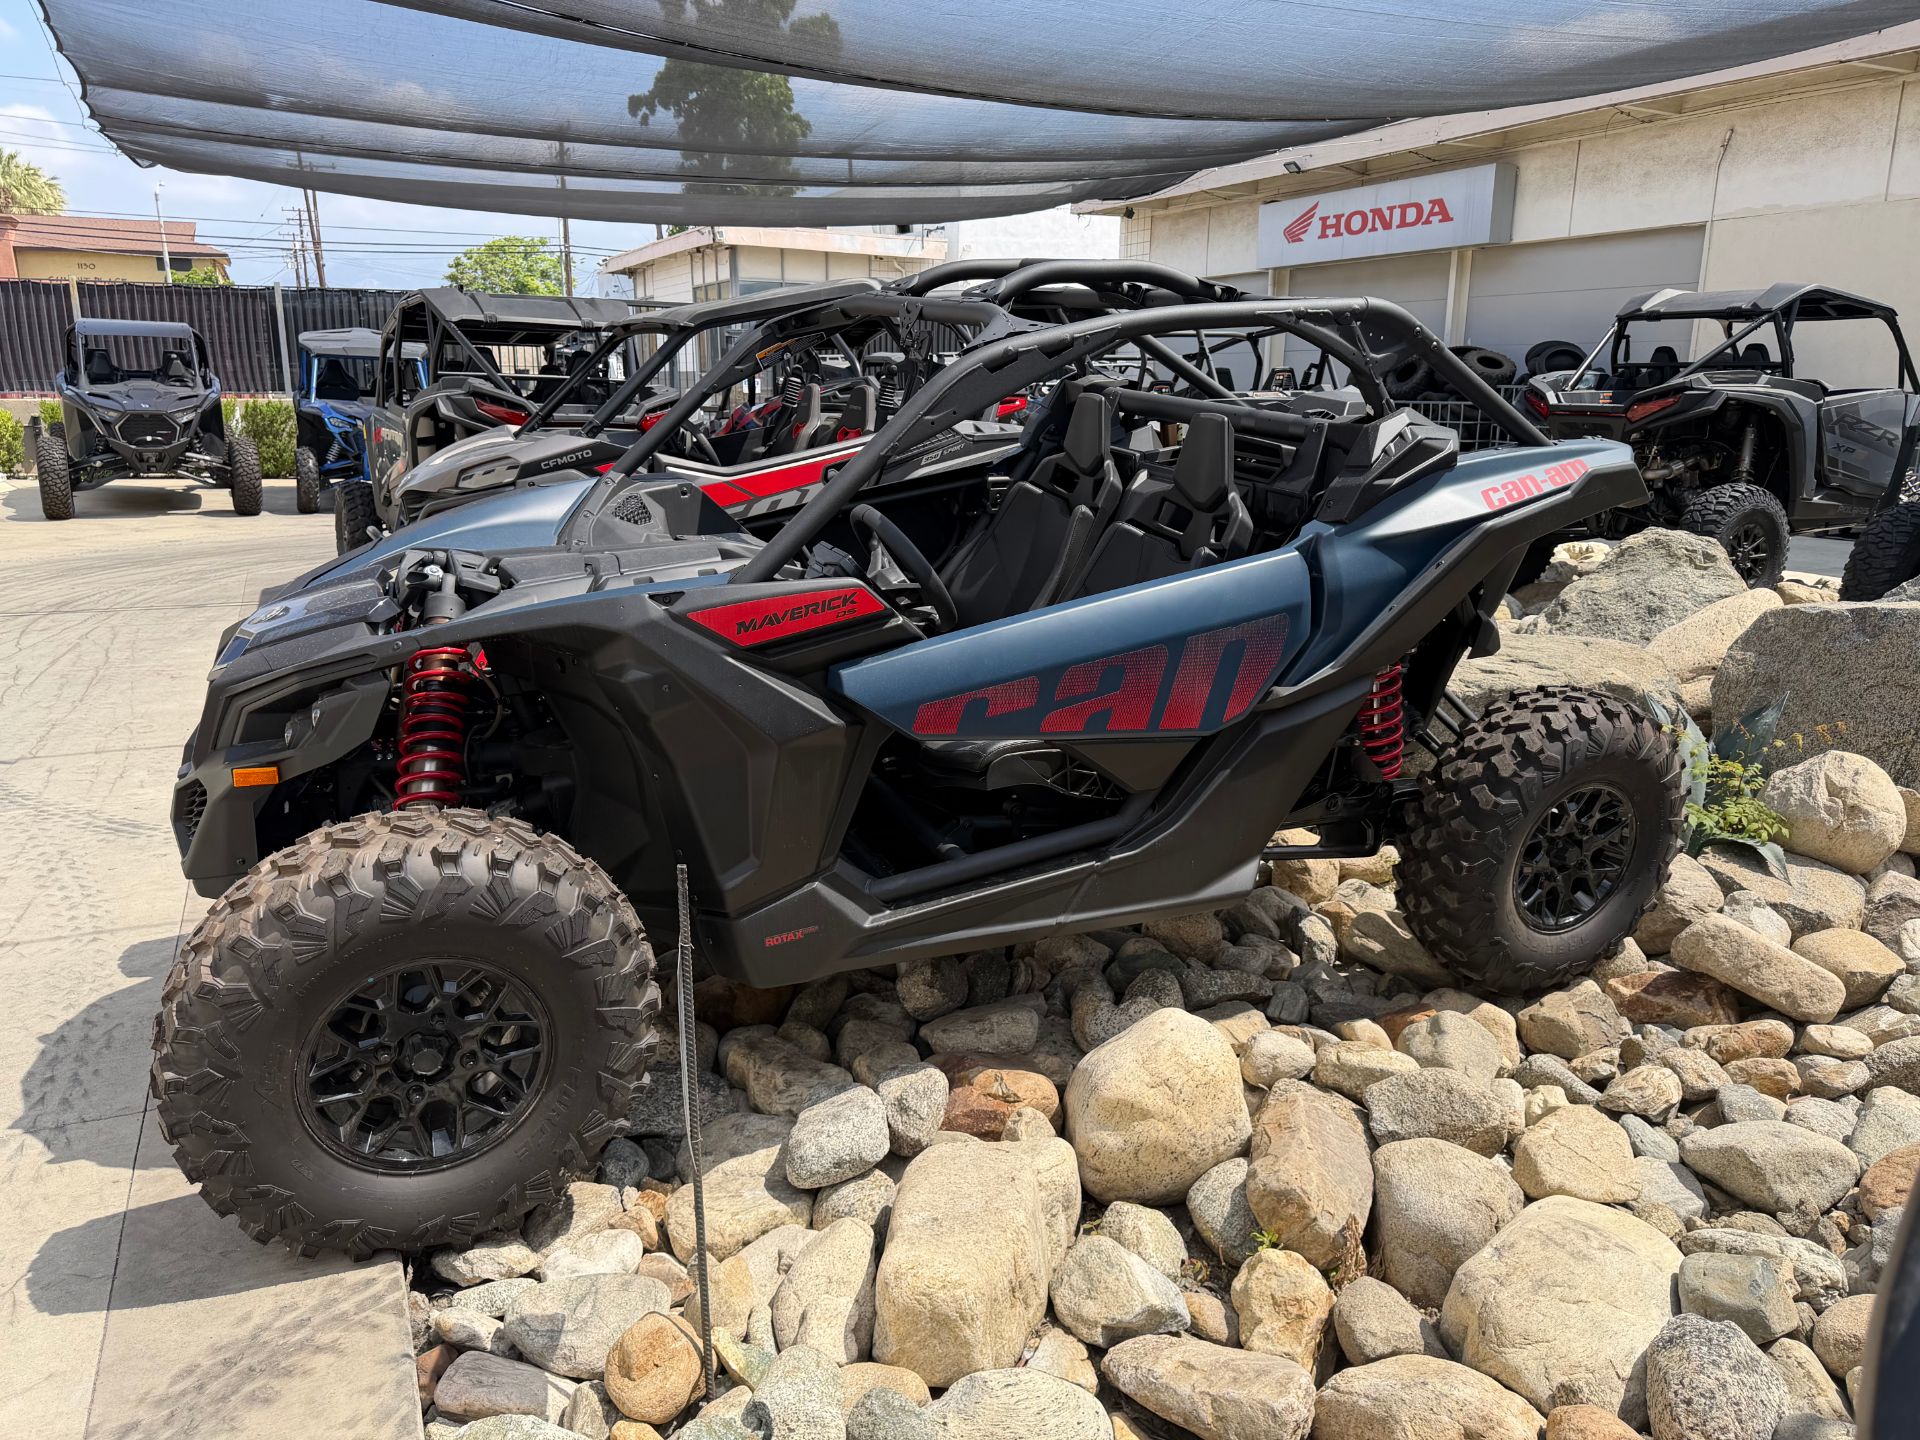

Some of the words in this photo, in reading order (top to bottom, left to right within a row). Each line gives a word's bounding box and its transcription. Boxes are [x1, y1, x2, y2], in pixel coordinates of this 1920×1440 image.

[1317, 198, 1454, 240] HONDA
[1828, 412, 1900, 448] RZR
[541, 449, 592, 469] CFMOTO
[1831, 442, 1856, 454] XP
[1480, 458, 1589, 511] can-am
[736, 592, 858, 635] MAVERICK
[836, 608, 857, 619] DS
[764, 929, 804, 947] ROTAX
